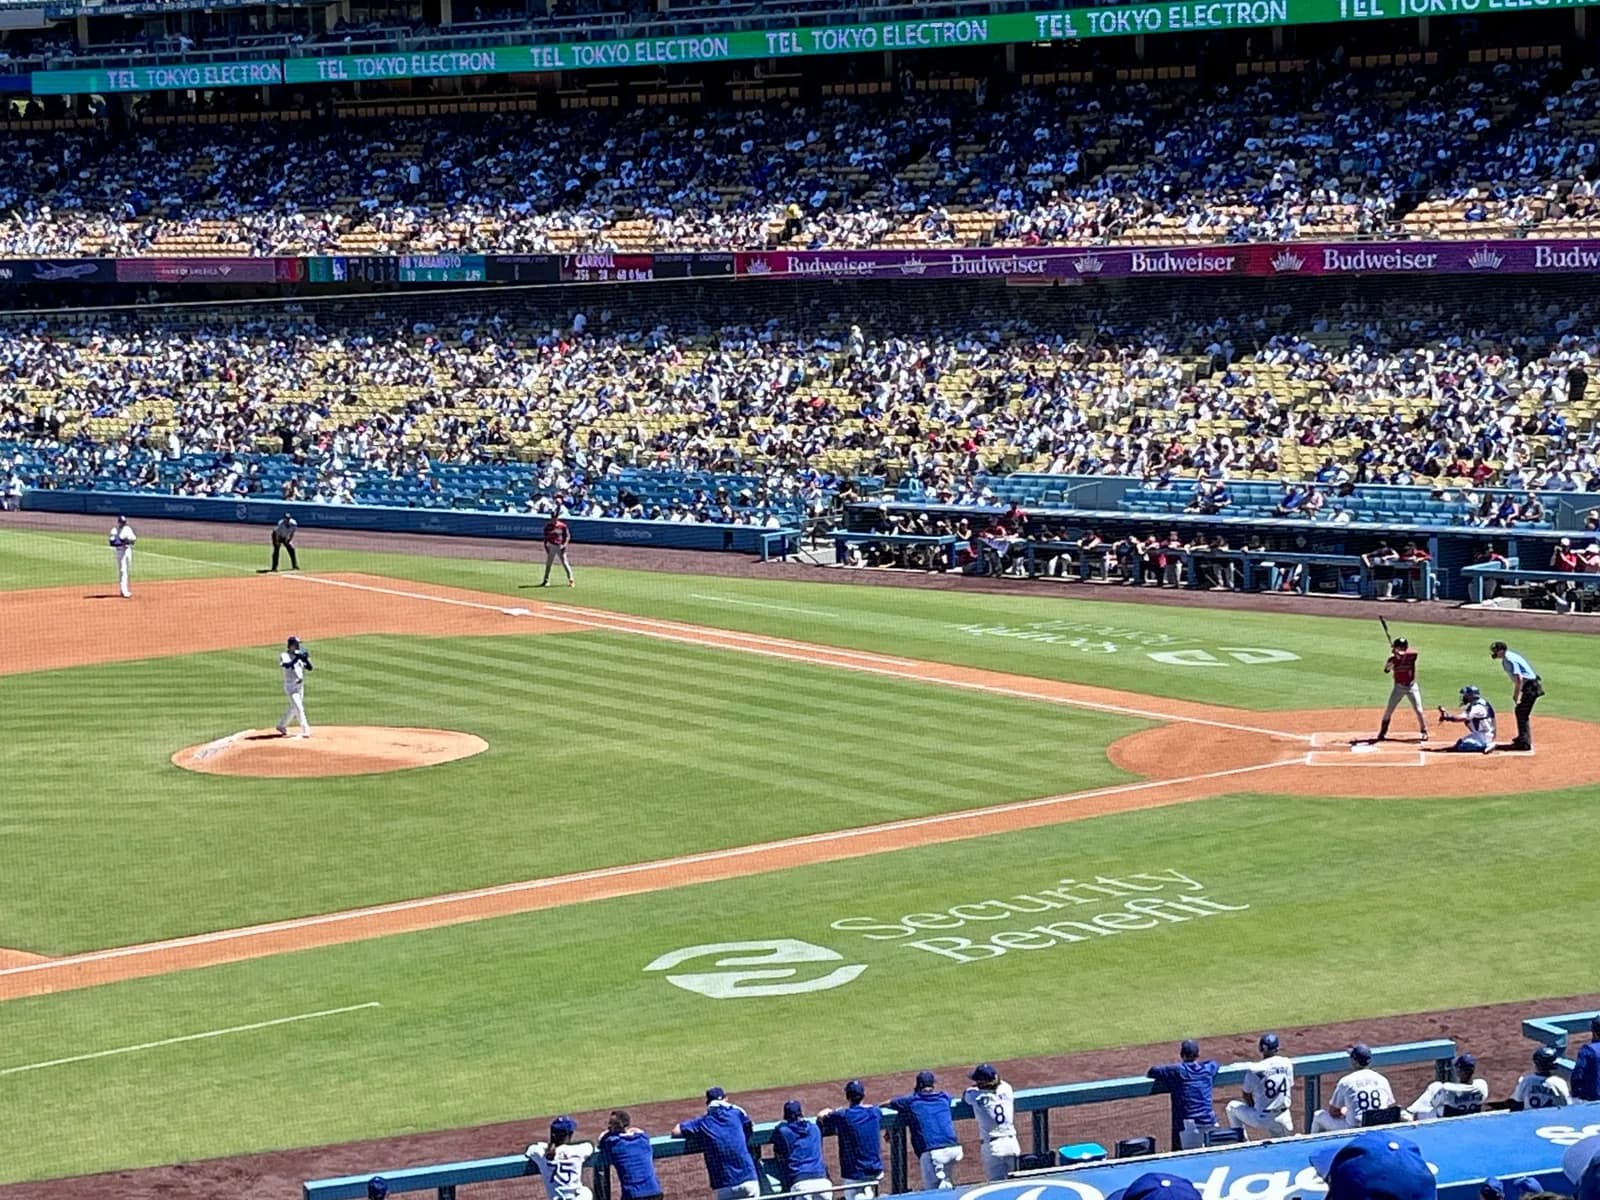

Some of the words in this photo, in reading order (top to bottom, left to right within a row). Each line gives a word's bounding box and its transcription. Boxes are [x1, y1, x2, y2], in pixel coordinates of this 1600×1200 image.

[1035, 14, 1077, 37] TEL
[1088, 8, 1162, 33] TOKYO
[1169, 1, 1287, 28] ELECTRON
[766, 32, 802, 54] TEL
[811, 27, 877, 50] TOKYO
[883, 20, 988, 46] ELECTRON
[530, 48, 565, 67] TEL
[572, 44, 630, 65] TOKYO
[636, 38, 728, 61] ELECTRON
[108, 71, 139, 88] TEL
[146, 68, 200, 87] TOKYO
[204, 63, 281, 84] ELECTRON
[317, 60, 347, 79] TEL
[354, 57, 407, 76] TOKYO
[412, 51, 496, 73] ELECTRON
[574, 254, 616, 268] CARROLL
[787, 256, 876, 275] Budweiser
[951, 254, 1047, 275] Budweiser
[1130, 252, 1235, 272] Budweiser
[1323, 248, 1438, 270] Budweiser
[830, 868, 1203, 939] Security
[901, 893, 1249, 963] Benefit
[1264, 1077, 1288, 1099] 84
[1357, 1090, 1381, 1110] 88
[994, 1104, 1005, 1125] 8
[546, 1162, 577, 1184] 75
